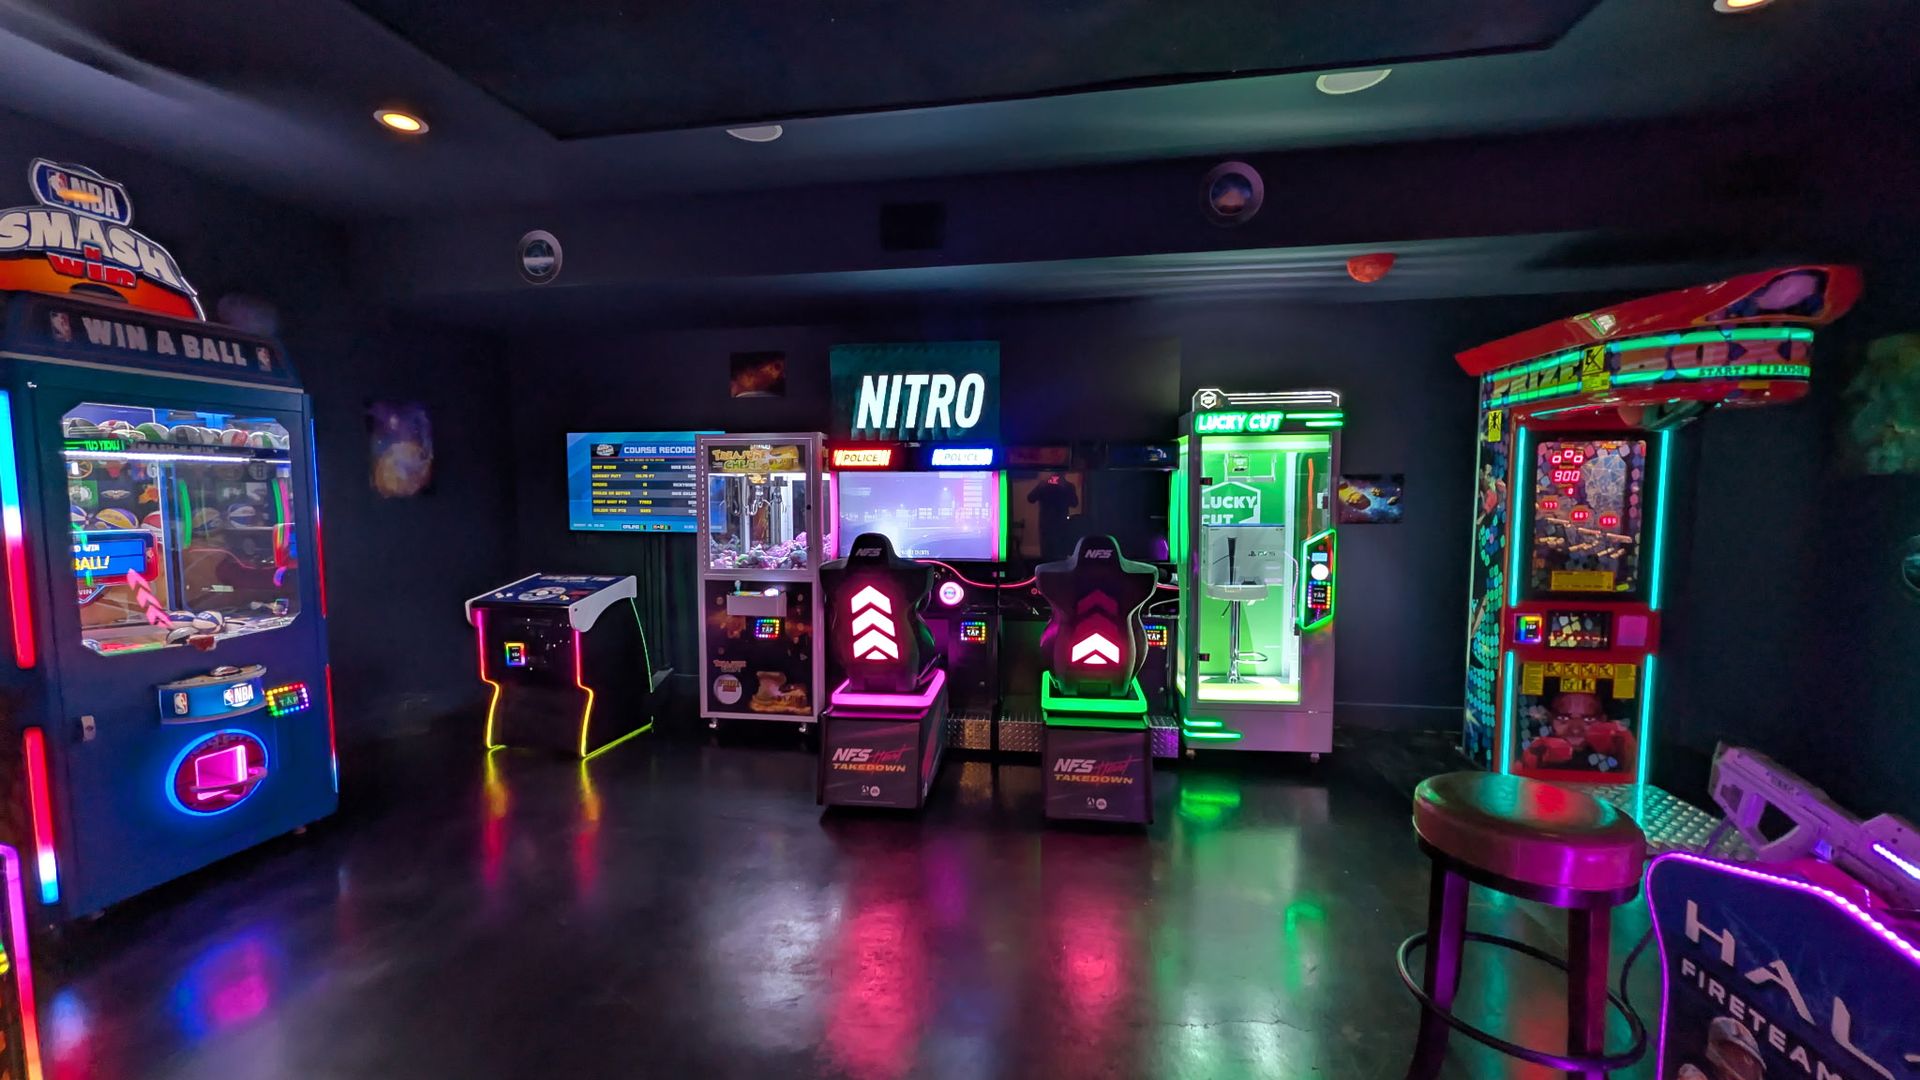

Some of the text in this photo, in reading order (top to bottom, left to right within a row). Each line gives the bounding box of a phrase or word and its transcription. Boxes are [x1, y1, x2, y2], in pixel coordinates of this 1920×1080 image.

[69, 176, 120, 218] NBA
[0, 211, 182, 289] SMASH
[82, 316, 247, 366] WIN A BALL
[856, 373, 986, 429] NITRO
[1197, 412, 1284, 432] LUCKY CUT
[624, 446, 656, 454] COURSE
[843, 453, 879, 463] POLICE
[1554, 470, 1580, 482] 900
[1201, 495, 1257, 509] LUCKY
[855, 547, 882, 557] NFS
[1084, 549, 1113, 559] NFS
[234, 684, 254, 703] NBA
[832, 747, 873, 762] NFS
[832, 763, 906, 772] TAKEDOWN
[1053, 758, 1097, 773] NFS
[1054, 774, 1134, 784] TAKEDOWN
[1685, 899, 1920, 1080] HAL
